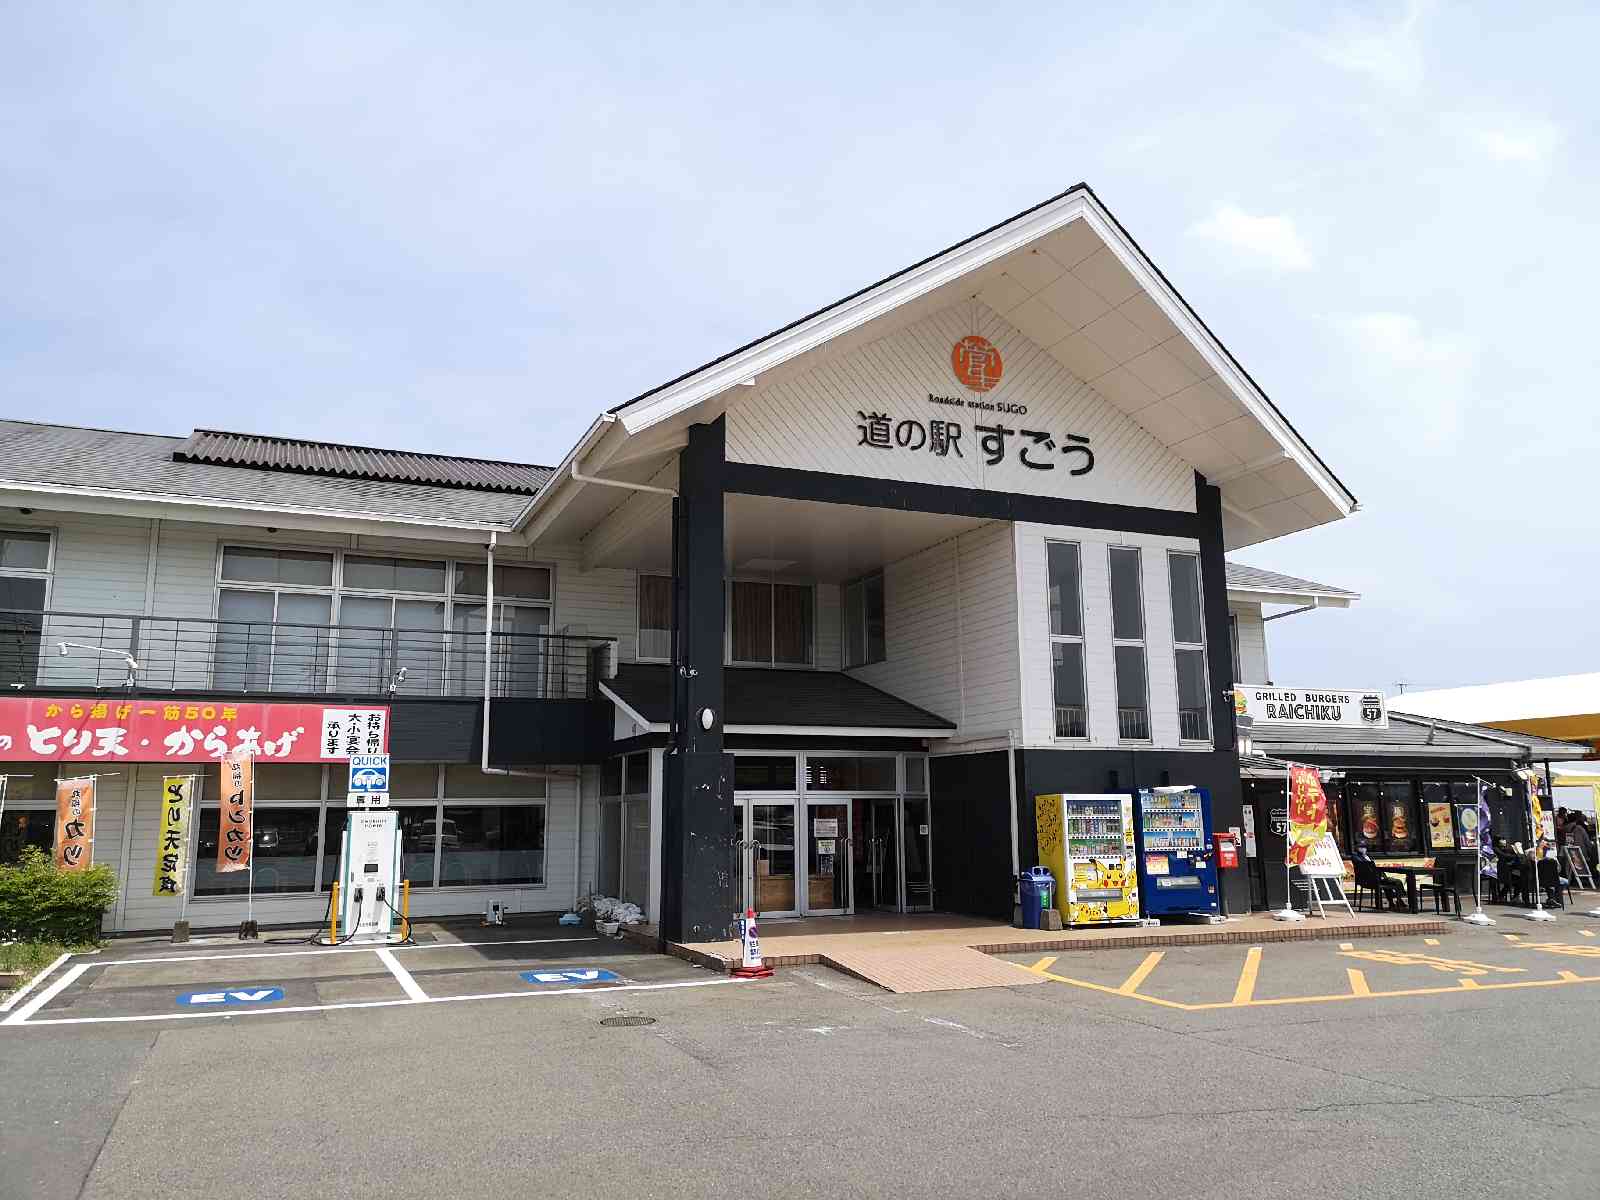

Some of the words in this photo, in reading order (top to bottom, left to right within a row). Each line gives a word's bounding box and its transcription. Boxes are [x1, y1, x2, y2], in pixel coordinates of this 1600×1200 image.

[928, 393, 965, 407] Roadside
[967, 400, 995, 411] station
[997, 402, 1028, 415] SUGO
[857, 410, 963, 458] 道の駅
[974, 423, 1095, 476] すごう
[1255, 692, 1297, 702] GRILLED
[1305, 693, 1350, 704] BURGERS
[45, 703, 238, 721] から揚げ一筋50年
[1266, 703, 1342, 721] RAICHIKU
[1366, 708, 1378, 719] 57
[366, 713, 381, 753] お持ち帰り
[352, 757, 387, 766] QUICK
[1276, 823, 1288, 833] 57
[533, 970, 599, 982] EV
[190, 990, 274, 1004] EV
